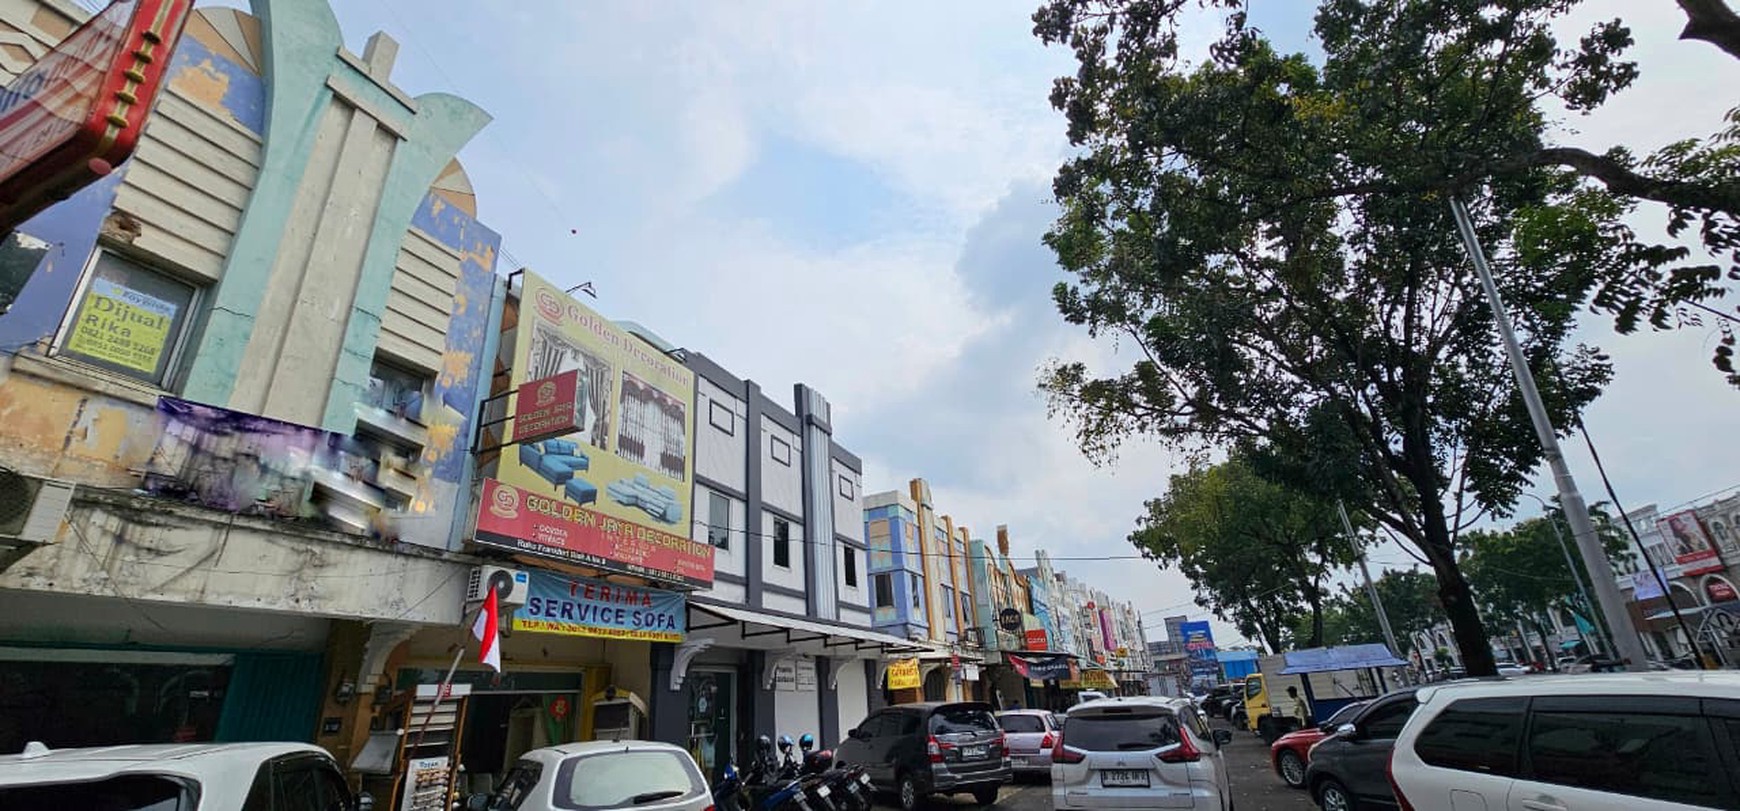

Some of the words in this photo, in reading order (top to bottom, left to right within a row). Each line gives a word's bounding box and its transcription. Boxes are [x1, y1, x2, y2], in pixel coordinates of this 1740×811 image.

[85, 314, 131, 338] Rika
[94, 297, 165, 330] Dijual
[567, 304, 620, 347] Golden
[623, 337, 689, 386] Decoration
[526, 495, 598, 528] GOLDEN
[598, 517, 634, 537] JAYA
[636, 527, 712, 558] DECORATION
[569, 580, 653, 608] TERIMA
[528, 596, 626, 626] SERVICE
[631, 611, 677, 631] SOFA
